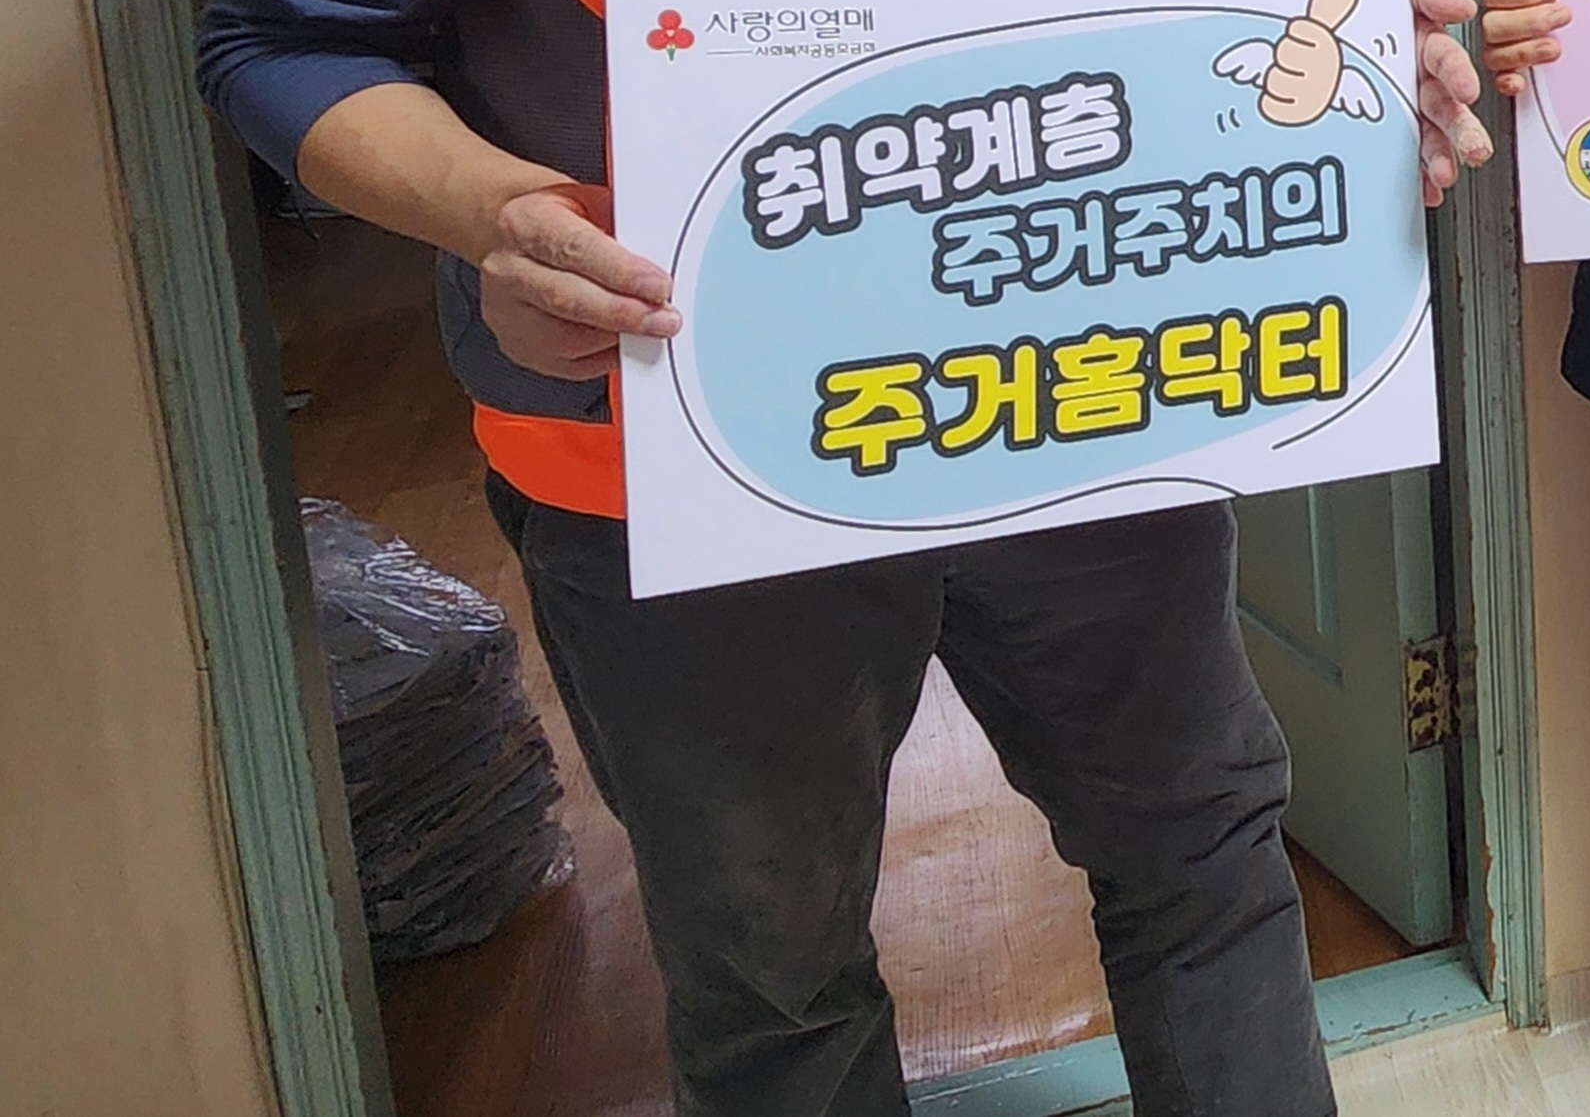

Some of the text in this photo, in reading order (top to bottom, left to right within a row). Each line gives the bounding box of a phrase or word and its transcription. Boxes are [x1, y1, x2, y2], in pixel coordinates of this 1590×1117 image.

[705, 8, 875, 43] 사랑의열매
[754, 42, 876, 59] 사회복지공동모금회
[744, 73, 1130, 247] 취약계층
[931, 157, 1347, 304] 주거주치의
[813, 298, 1348, 474] 주거홈닥터
